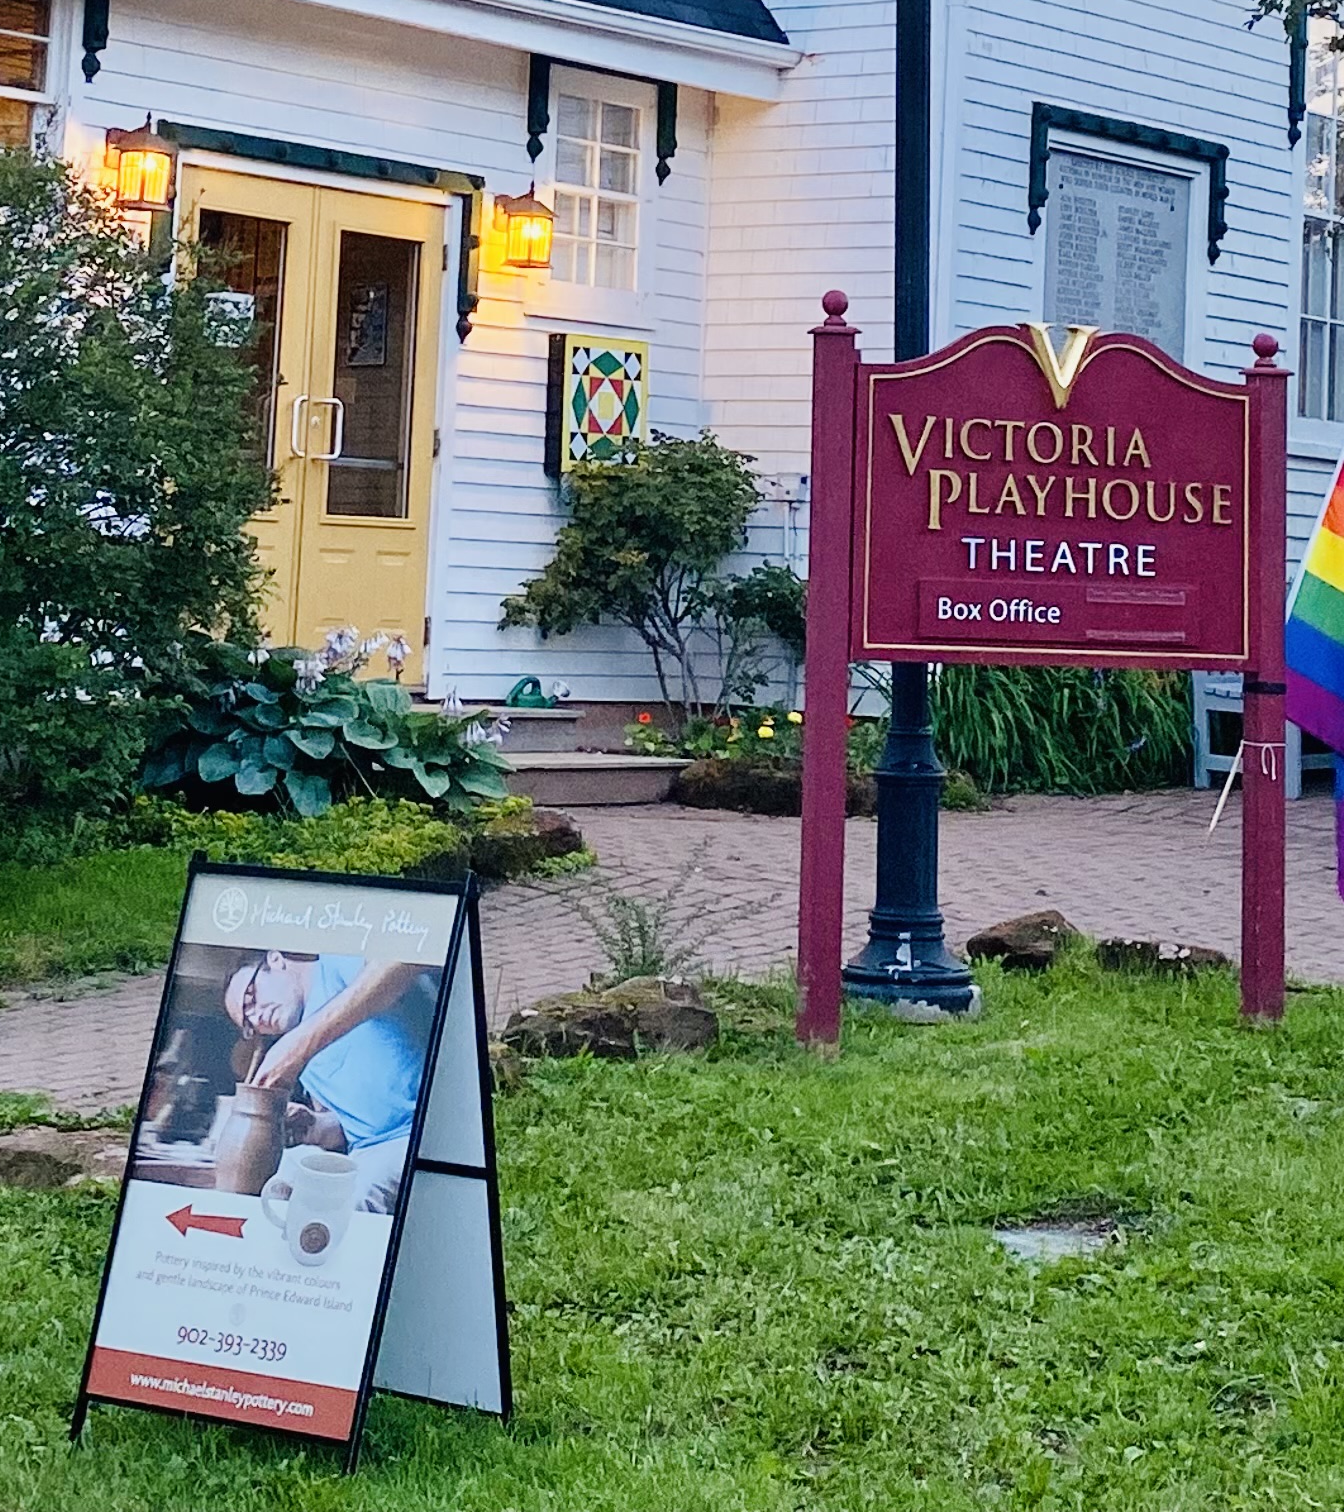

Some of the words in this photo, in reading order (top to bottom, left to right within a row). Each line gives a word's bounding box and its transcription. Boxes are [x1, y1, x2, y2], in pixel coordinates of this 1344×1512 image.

[888, 413, 1152, 476] VICTORIA
[927, 468, 1233, 530] PLAYHOUSE
[961, 536, 1157, 576] THEATRE
[937, 596, 982, 621] Box
[989, 599, 1061, 624] Office
[250, 895, 313, 930] Michael
[317, 901, 374, 950] Stanley
[381, 908, 431, 952] Pottery
[156, 1251, 189, 1269] Pottery
[192, 1259, 231, 1275] inspired
[233, 1263, 246, 1279] by
[248, 1266, 264, 1279] the
[267, 1268, 302, 1285] vibrant
[136, 1269, 155, 1281] and
[156, 1272, 186, 1286] gentle
[187, 1274, 234, 1294] landscape
[236, 1283, 248, 1295] of
[250, 1284, 281, 1301] Prince
[283, 1290, 320, 1307] Edward
[323, 1297, 353, 1312] Island
[176, 1326, 288, 1362] 902-393-2339
[129, 1372, 315, 1416] www.michaelstanleypottery.com
